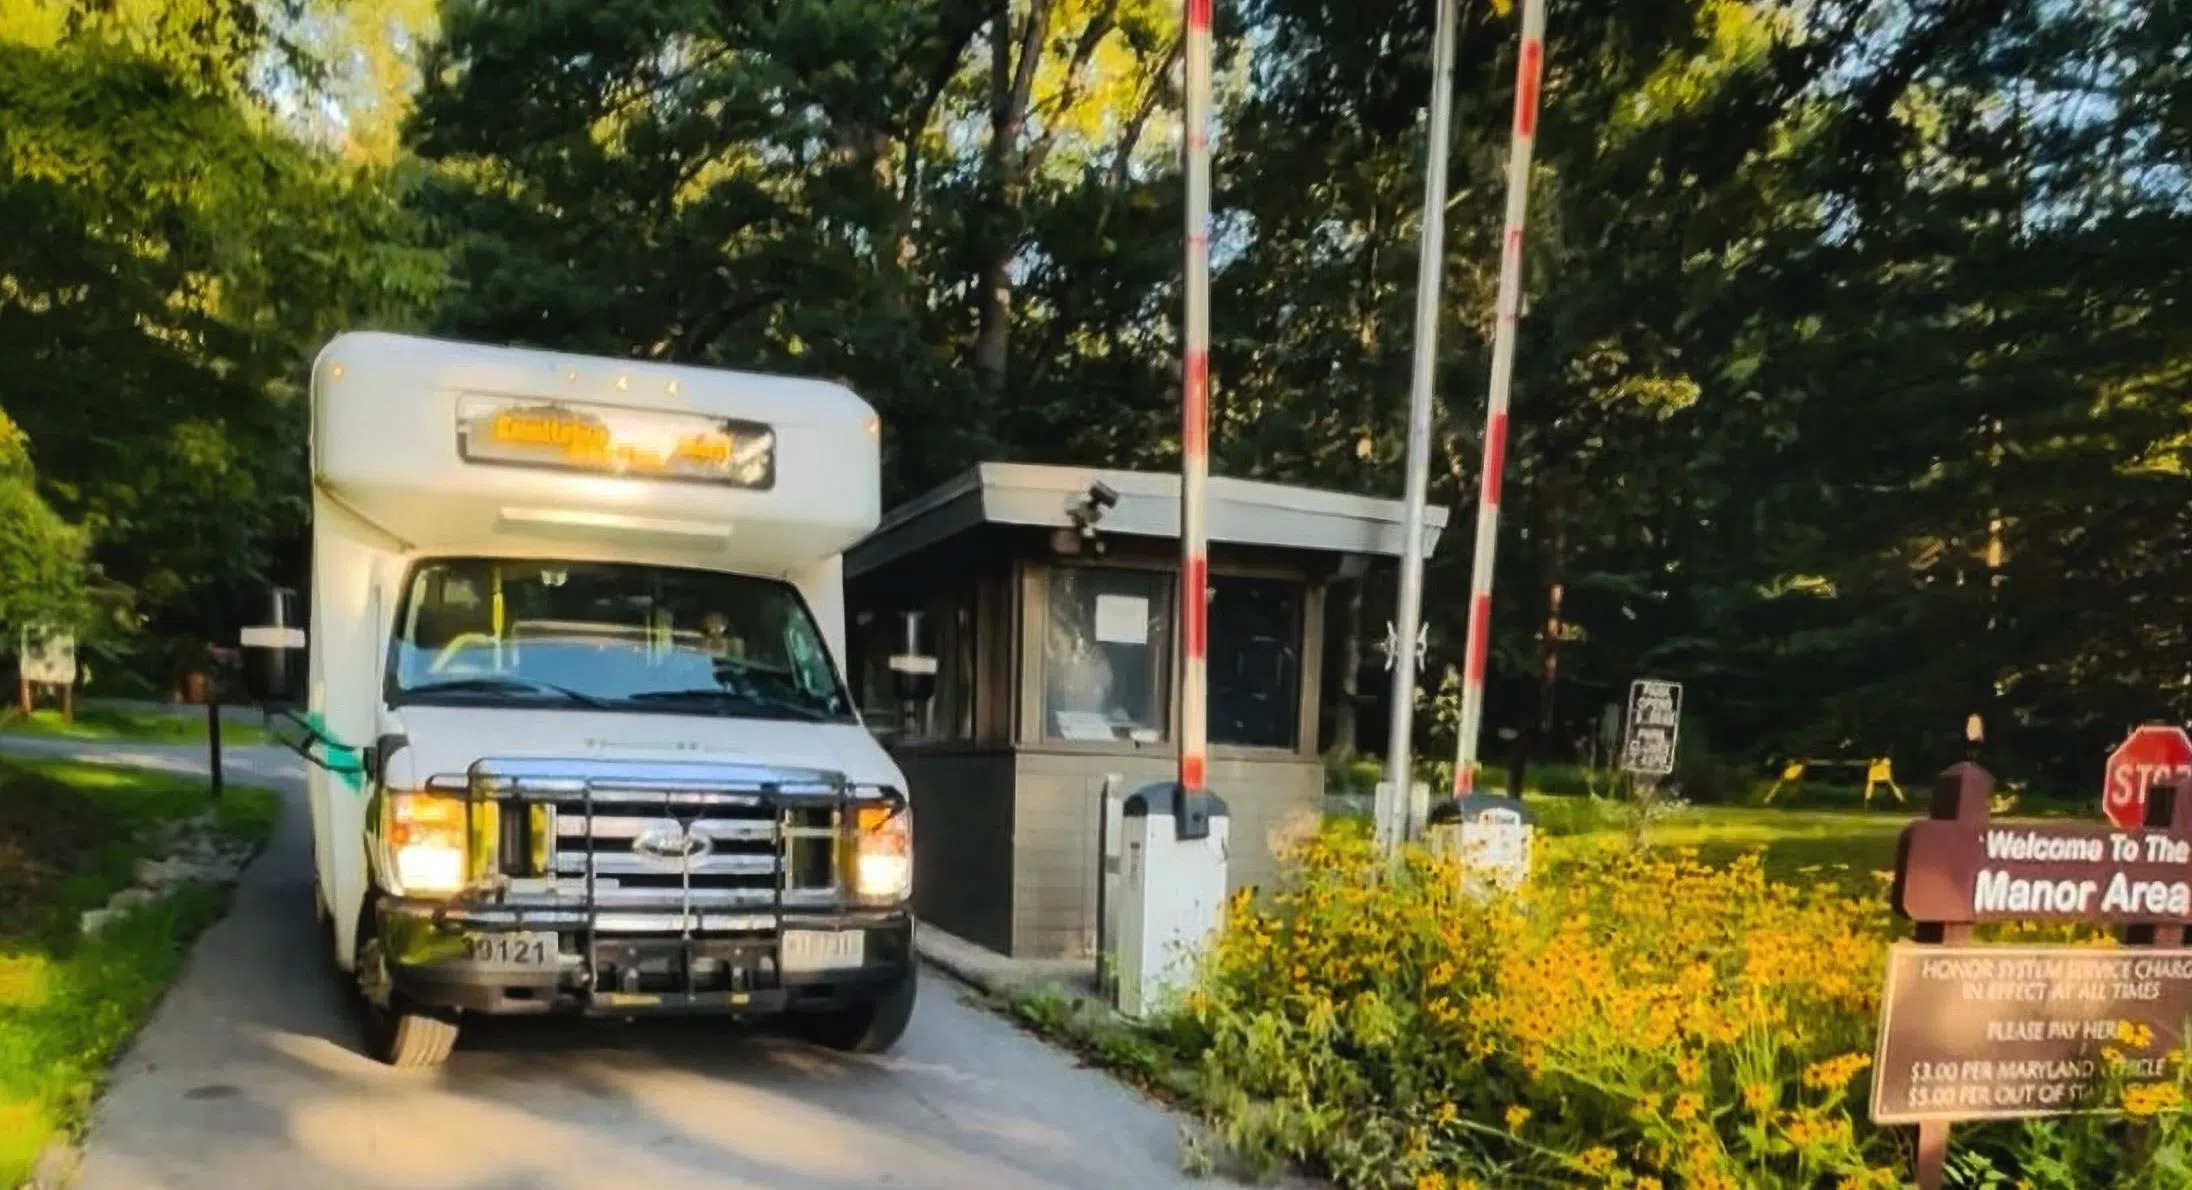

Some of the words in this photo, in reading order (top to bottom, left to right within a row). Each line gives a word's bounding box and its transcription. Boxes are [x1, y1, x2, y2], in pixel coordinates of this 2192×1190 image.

[2112, 763, 2191, 805] ST
[1986, 829, 2103, 862] Welcome
[2110, 832, 2139, 863] To
[2145, 833, 2190, 864] The
[1974, 869, 2098, 914] Manor
[2101, 871, 2191, 916] Area
[1922, 959, 1994, 979] HONOR
[2111, 981, 2160, 1000] TIMES
[1987, 1020, 2044, 1040] PLEASE
[2047, 1020, 2079, 1039] PAY
[1961, 1060, 1993, 1081] PER
[1996, 1059, 2094, 1080] MARYLAND
[1959, 1085, 1993, 1105] PER
[1994, 1084, 2034, 1105] OUT
[2037, 1083, 2065, 1104] OF
